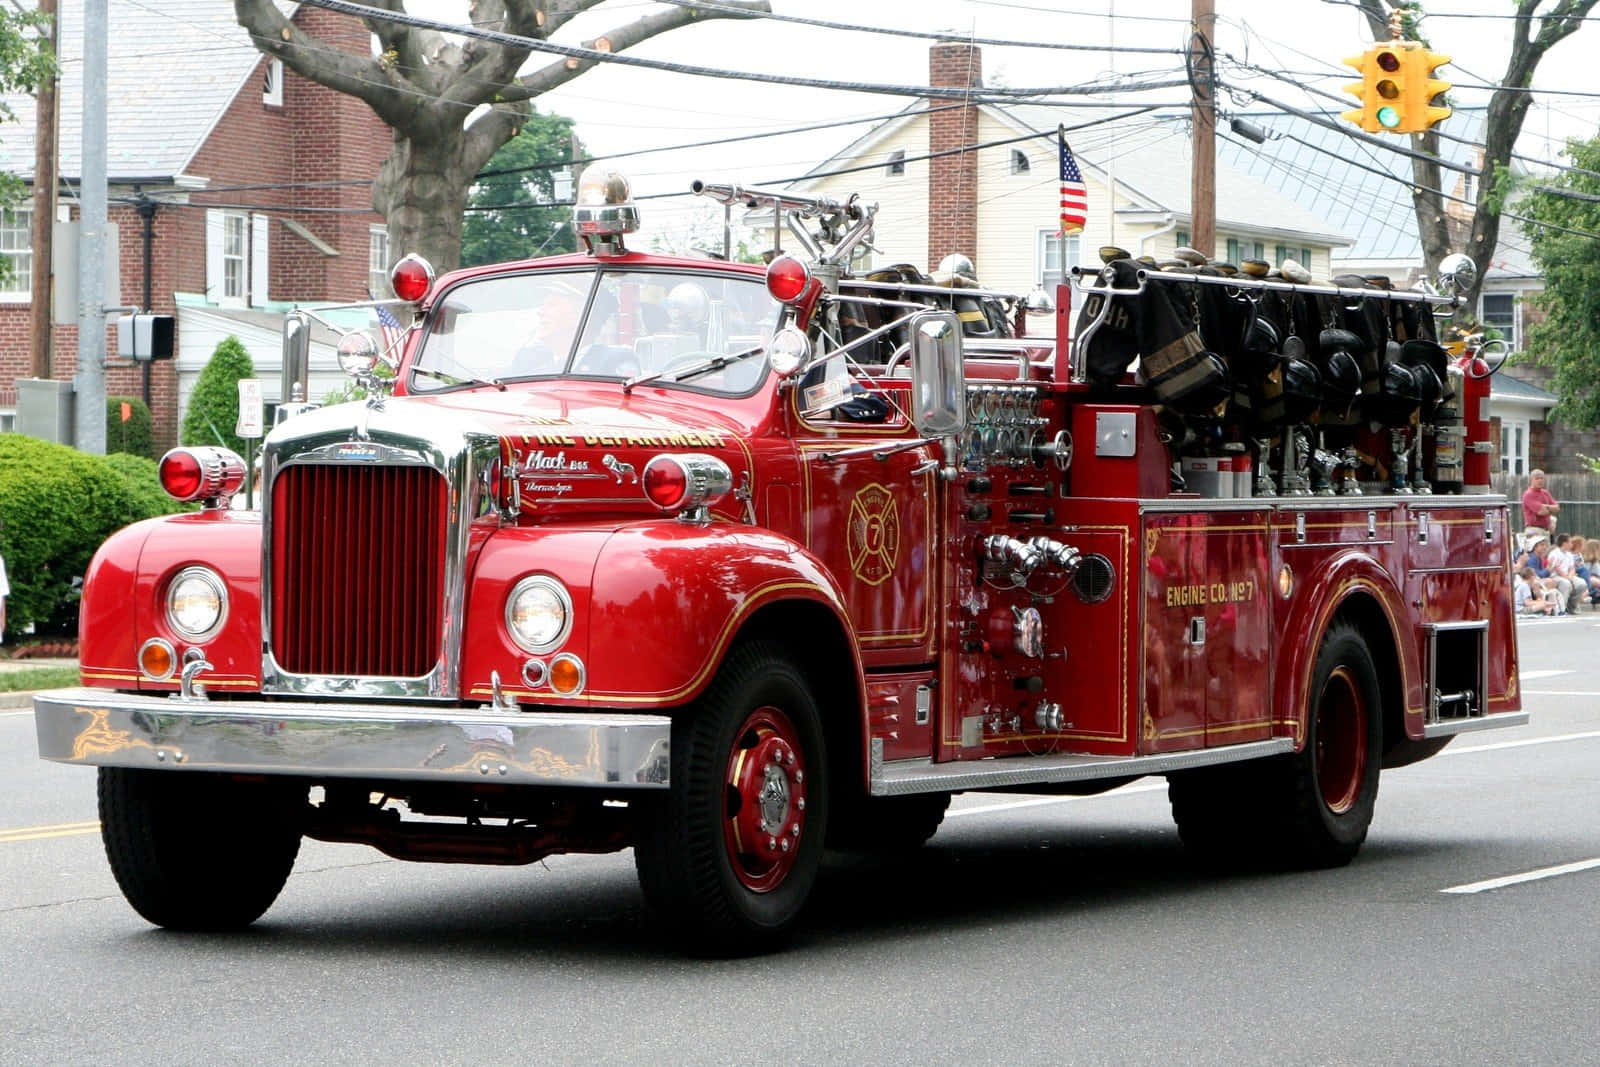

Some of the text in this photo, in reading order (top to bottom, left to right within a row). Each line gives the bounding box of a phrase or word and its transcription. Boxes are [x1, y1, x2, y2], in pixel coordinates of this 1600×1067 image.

[524, 450, 566, 471] Mack
[870, 523, 880, 546] 7
[1166, 585, 1207, 607] ENGINE
[1210, 583, 1228, 602] CO.
